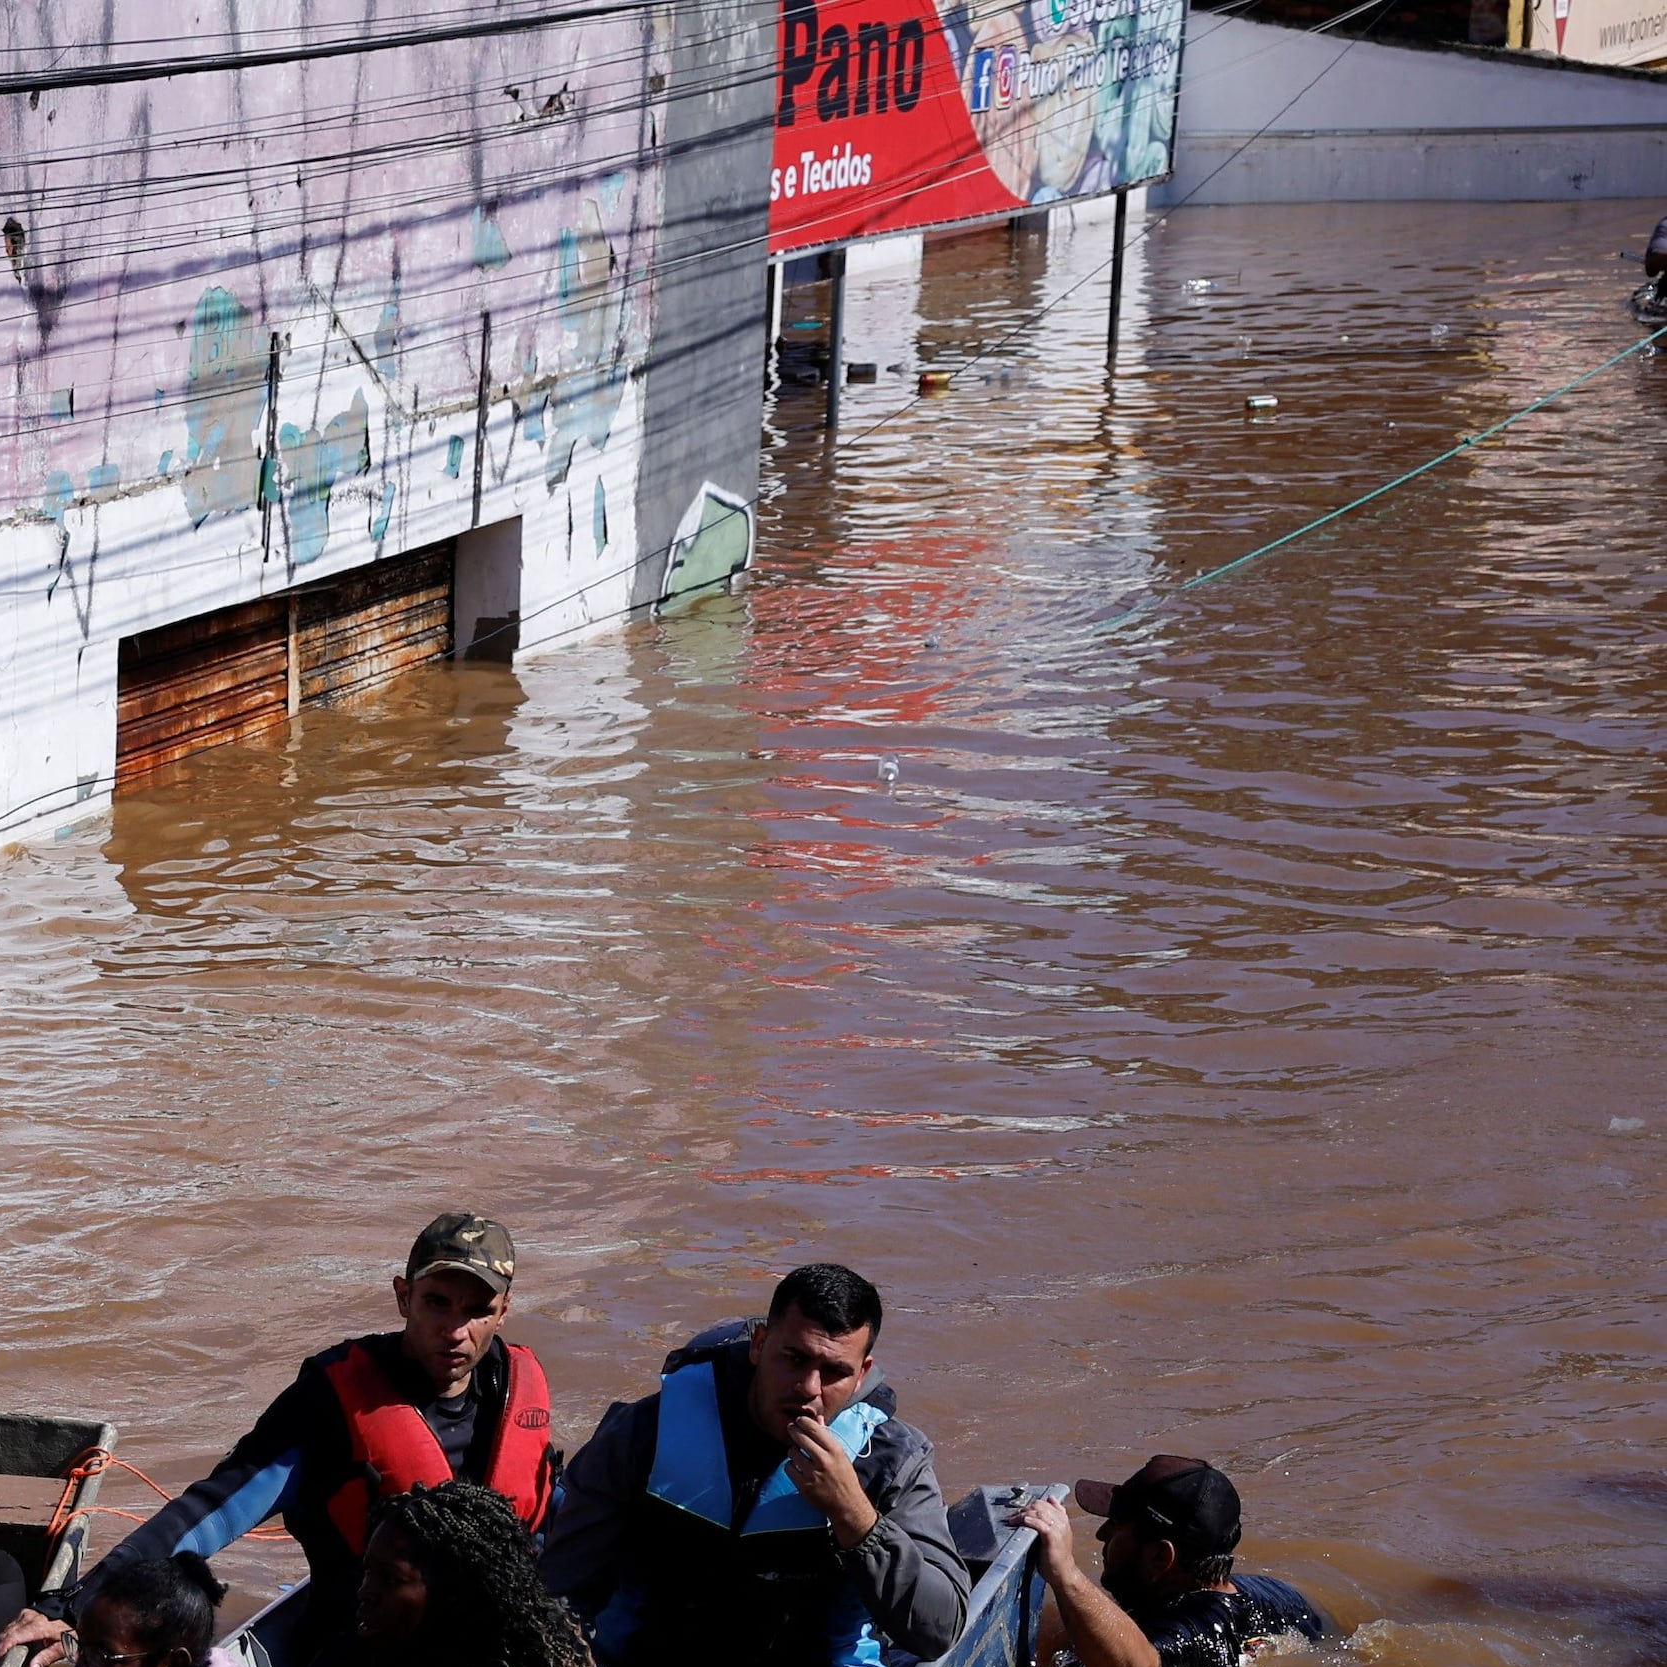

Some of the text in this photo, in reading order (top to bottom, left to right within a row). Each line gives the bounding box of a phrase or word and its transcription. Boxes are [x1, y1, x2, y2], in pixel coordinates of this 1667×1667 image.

[778, 0, 924, 128] Pano
[1017, 51, 1060, 100] Puro
[1063, 43, 1106, 93] Pano
[1109, 38, 1173, 81] Tecidos
[784, 165, 797, 198] e
[801, 142, 872, 195] Tecidos
